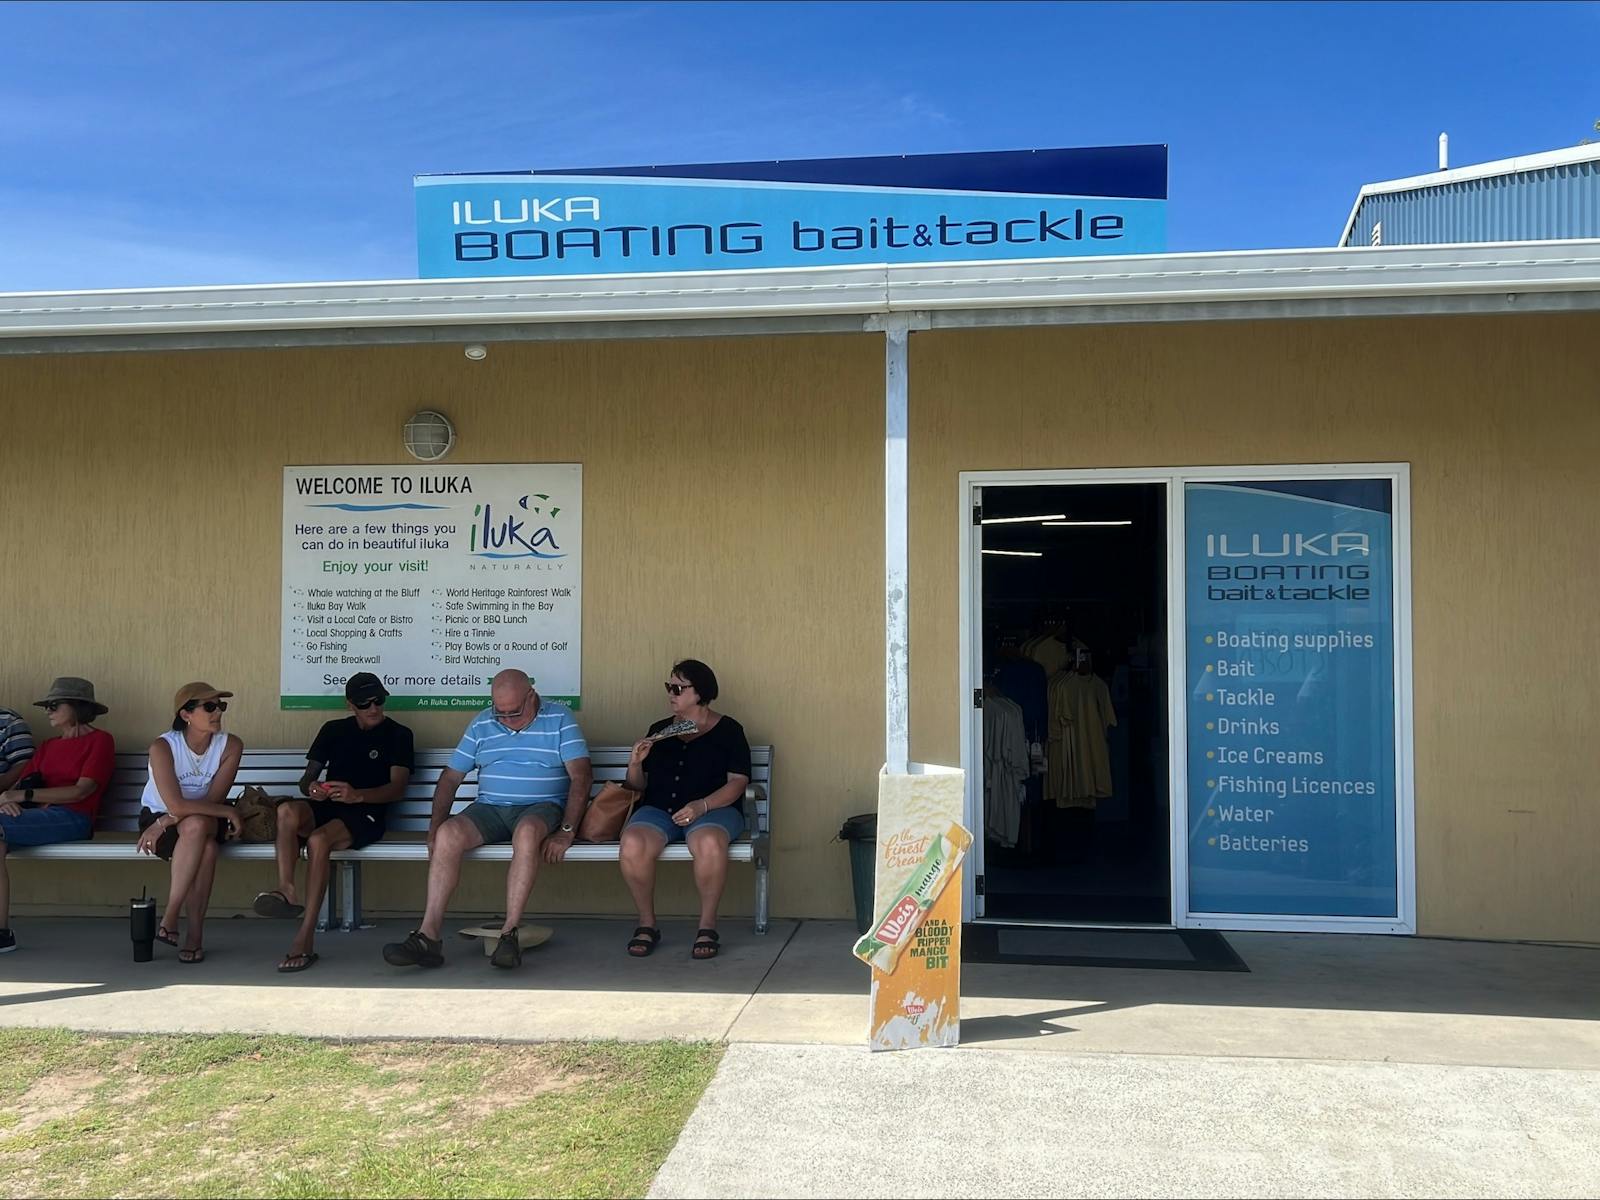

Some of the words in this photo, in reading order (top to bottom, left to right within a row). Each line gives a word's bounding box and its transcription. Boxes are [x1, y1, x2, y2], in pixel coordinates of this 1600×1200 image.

[453, 196, 600, 225] ILUKA
[454, 223, 763, 262] BOATING
[792, 209, 1125, 250] bait&tackle
[296, 476, 383, 495] WELCOME
[391, 476, 413, 494] TO
[420, 475, 473, 494] ILUKA
[295, 523, 324, 535] Here
[328, 525, 348, 535] are
[352, 525, 360, 535] a
[364, 523, 387, 535] few
[391, 523, 429, 538] things
[434, 525, 456, 537] you
[470, 503, 559, 555] iluka
[301, 541, 324, 551] can
[328, 539, 344, 550] do
[348, 538, 359, 550] in
[363, 538, 416, 550] beautiful
[420, 537, 449, 550] iluka
[1206, 531, 1370, 558] ILUKA
[322, 560, 358, 575] Enjoy
[364, 562, 393, 575] your
[399, 559, 429, 572] visit!
[470, 563, 564, 571] NATURALLY
[1207, 564, 1370, 581] BOATING
[307, 588, 334, 598] Whale
[335, 588, 373, 600] watching
[373, 588, 383, 598] at
[385, 588, 399, 598] the
[401, 588, 421, 598] Bluff
[445, 588, 470, 597] World
[471, 588, 506, 599] Heritage
[507, 588, 548, 597] Rainforest
[550, 588, 572, 597] Walk
[1207, 584, 1370, 601] bait&tackle
[306, 601, 326, 611] Iluka
[328, 601, 344, 613] Bay
[346, 601, 367, 611] Walk
[445, 601, 464, 611] Safe
[466, 601, 510, 613] Swimming
[511, 601, 520, 611] in
[522, 601, 536, 611] the
[538, 601, 554, 613] Bay
[306, 615, 325, 624] Visit
[334, 615, 356, 624] Local
[357, 615, 377, 624] Cafe
[378, 616, 388, 624] or
[390, 615, 414, 624] Bistro
[445, 615, 469, 624] Picnic
[471, 616, 481, 624] or
[483, 615, 501, 624] BBQ
[503, 615, 528, 624] Lunch
[306, 628, 328, 638] Local
[329, 628, 367, 640] Shopping
[368, 628, 377, 638] &
[378, 628, 403, 638] Crafts
[444, 628, 462, 638] Hire
[463, 630, 470, 638] a
[471, 628, 496, 638] Tinnie
[306, 641, 318, 651] Go
[319, 641, 348, 653] Fishing
[444, 641, 463, 653] Play
[465, 641, 491, 651] Bowls
[492, 642, 502, 651] or
[503, 643, 510, 651] a
[511, 641, 538, 651] Round
[539, 641, 549, 651] of
[551, 641, 568, 651] Golf
[1217, 631, 1289, 653] Boating
[1293, 630, 1374, 653] supplies
[306, 655, 323, 664] Surf
[325, 655, 339, 664] the
[341, 655, 381, 664] Breakwall
[444, 655, 461, 664] Bird
[462, 655, 501, 666] Watching
[1217, 659, 1256, 677] Bait
[323, 674, 347, 686] See
[383, 674, 399, 686] for
[404, 676, 436, 686] more
[440, 674, 482, 686] details
[417, 698, 429, 707] An
[450, 698, 485, 707] Chamber
[1217, 687, 1275, 706] Tackle
[1218, 716, 1280, 736] Drinks
[1217, 746, 1249, 764] Ice
[1253, 746, 1324, 765] Creams
[1218, 775, 1287, 799] Fishing
[1292, 776, 1375, 796] Licences
[1218, 805, 1275, 823] Water
[1219, 833, 1309, 853] Batteries
[915, 858, 942, 897] mango
[878, 902, 915, 941] Weis
[924, 919, 940, 928] AND
[941, 918, 947, 926] A
[915, 925, 954, 938] BLOODY
[917, 936, 951, 948] RIPPER
[910, 946, 947, 958] MANGO
[925, 955, 949, 970] BIT
